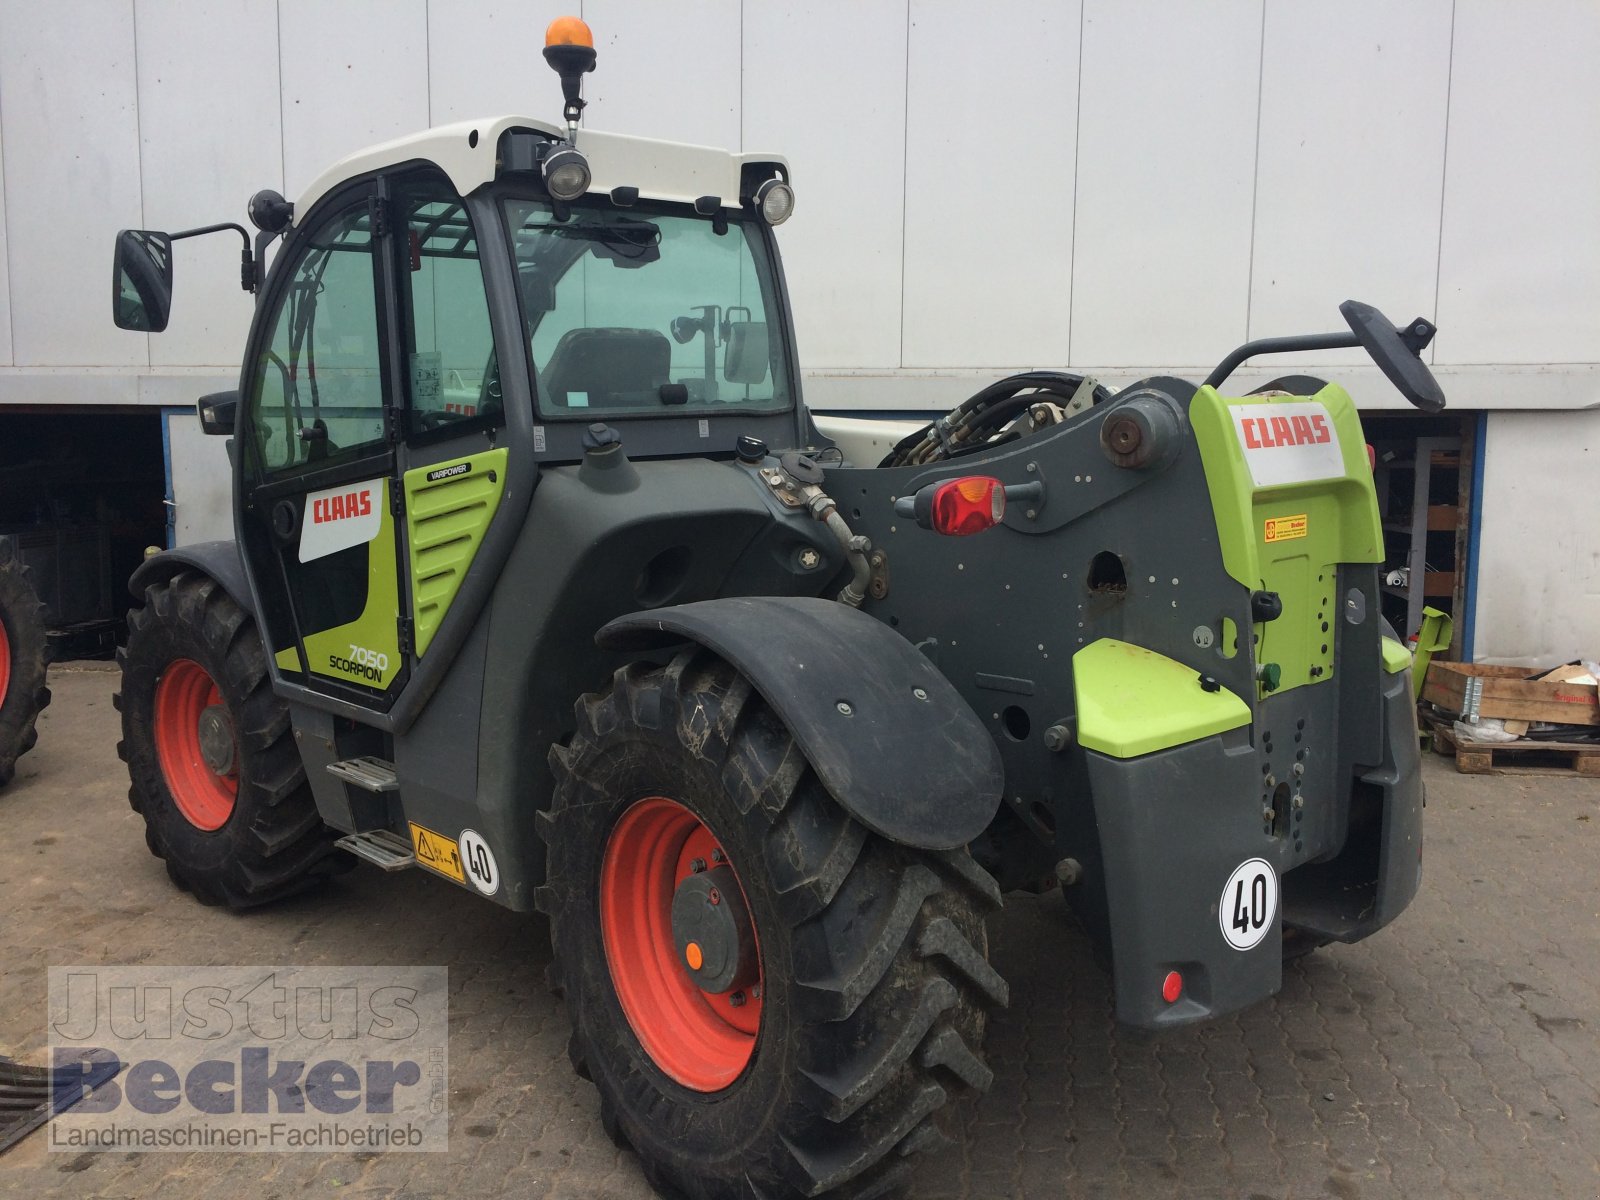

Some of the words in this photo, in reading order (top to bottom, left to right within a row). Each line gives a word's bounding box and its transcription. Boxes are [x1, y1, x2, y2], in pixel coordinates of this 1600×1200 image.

[1241, 415, 1331, 449] CLAAS
[431, 464, 467, 480] VARIPOWER
[313, 490, 371, 524] CLAAS
[329, 655, 382, 683] SCORPION
[350, 644, 388, 671] 7050
[467, 840, 492, 883] 40
[1233, 873, 1267, 934] 40
